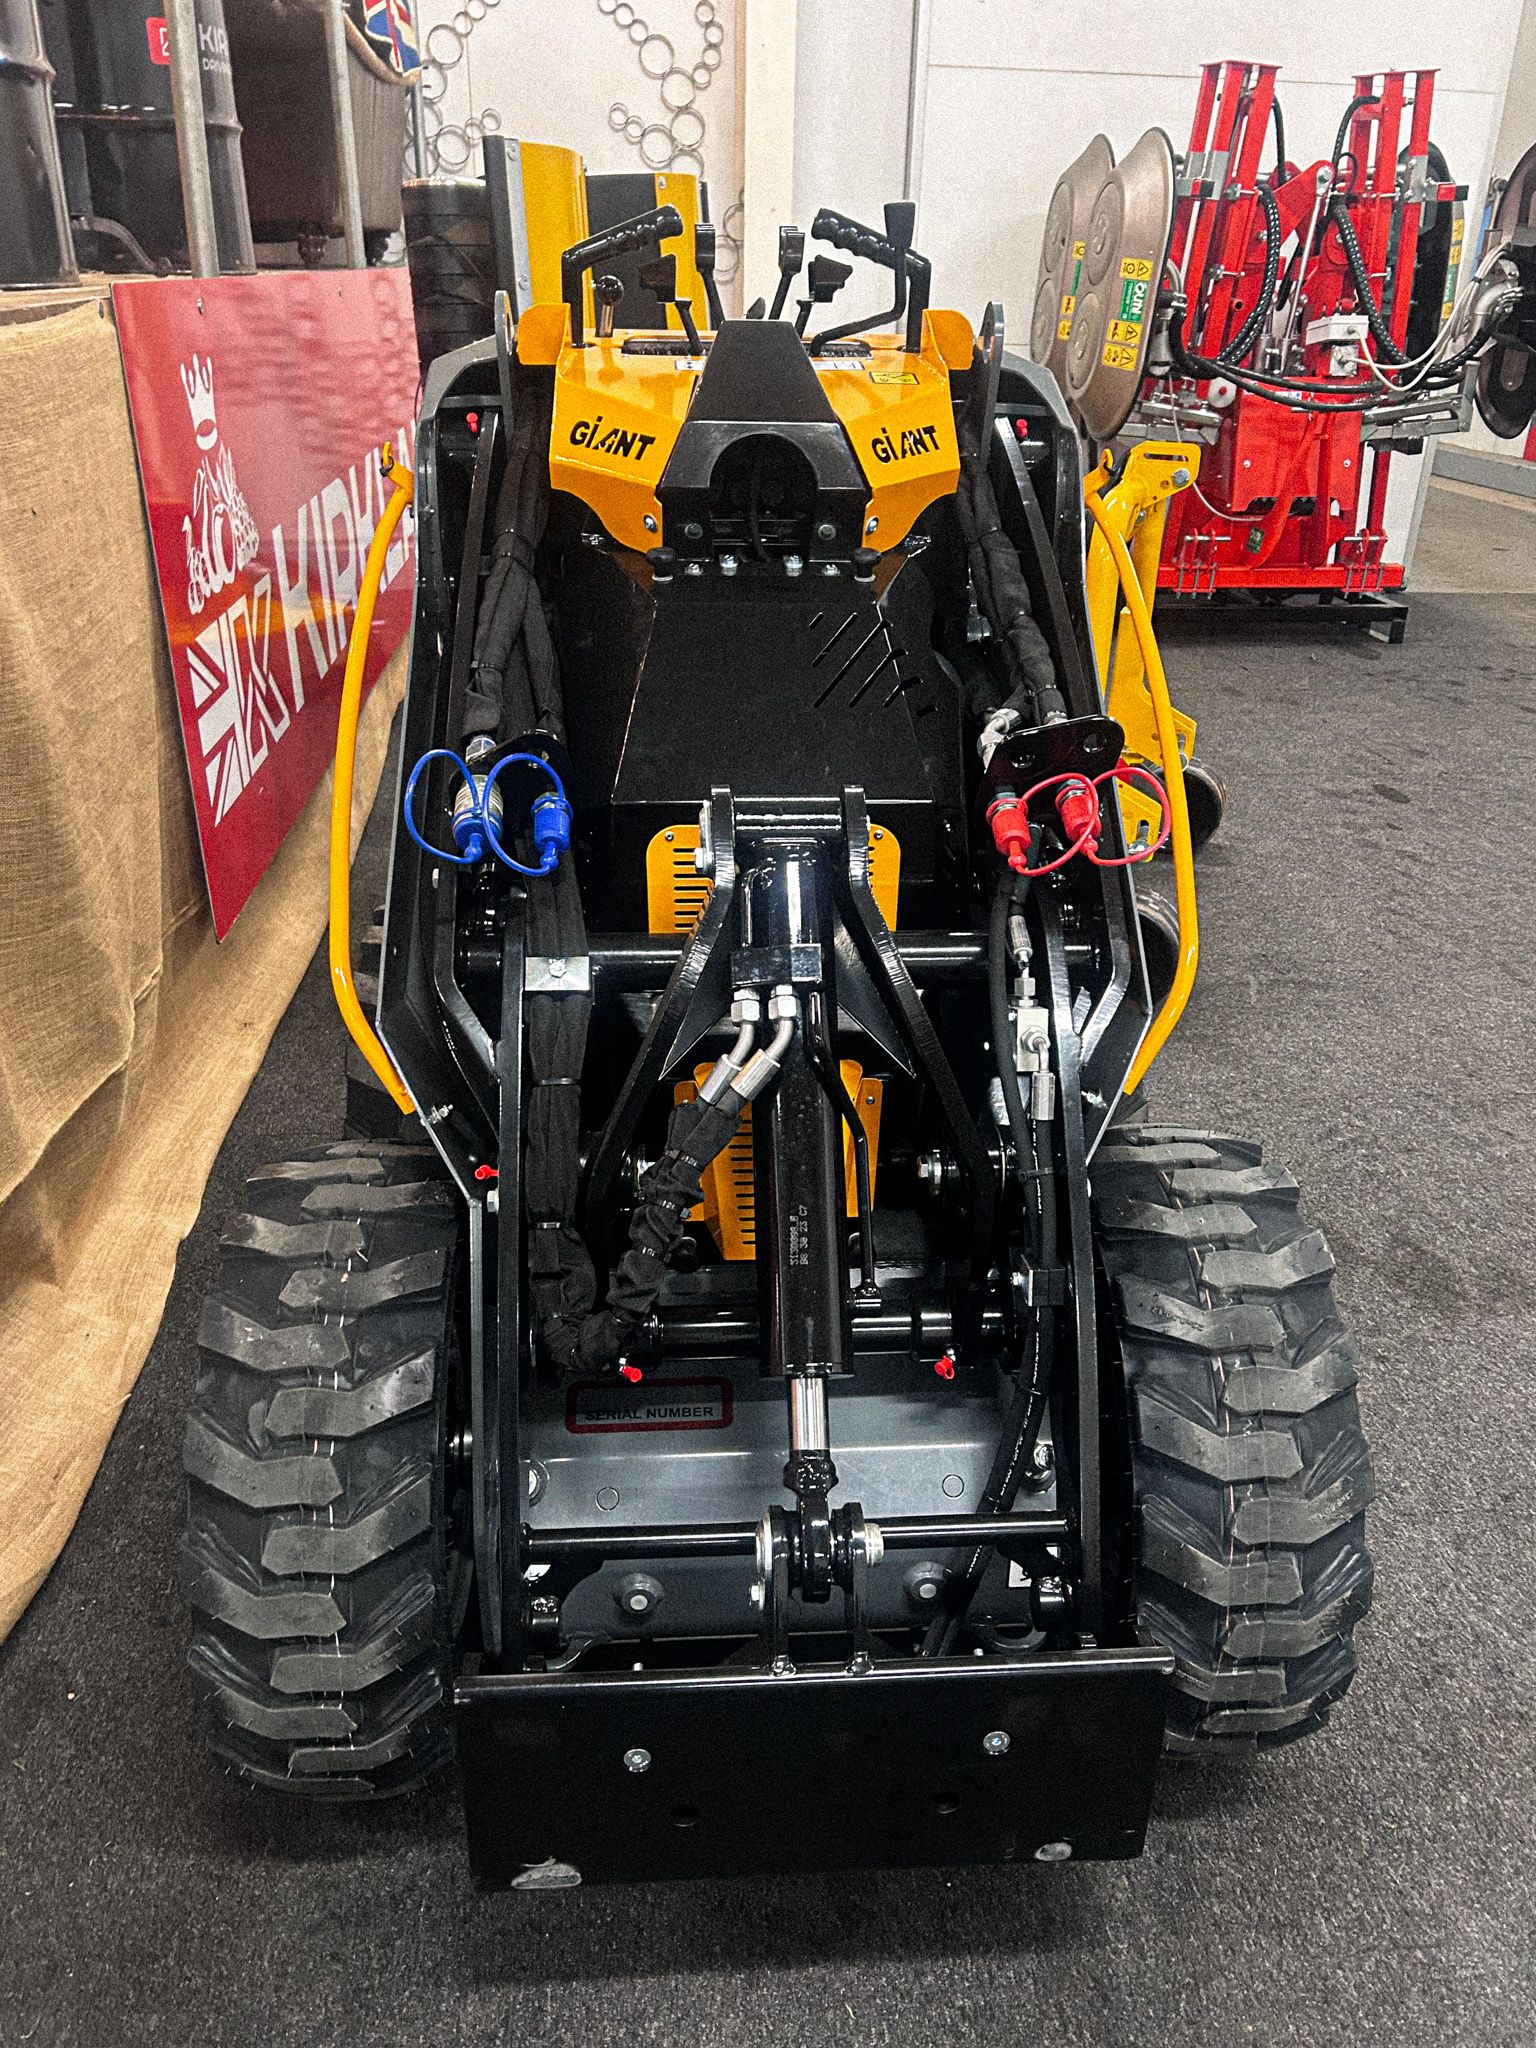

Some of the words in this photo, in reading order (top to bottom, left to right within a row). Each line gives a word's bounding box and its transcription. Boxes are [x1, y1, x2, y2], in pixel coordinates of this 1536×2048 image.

[569, 416, 656, 461] GiANT
[871, 424, 940, 464] GiANT
[585, 1408, 642, 1421] SERIAL
[646, 1406, 714, 1419] NUMBER
